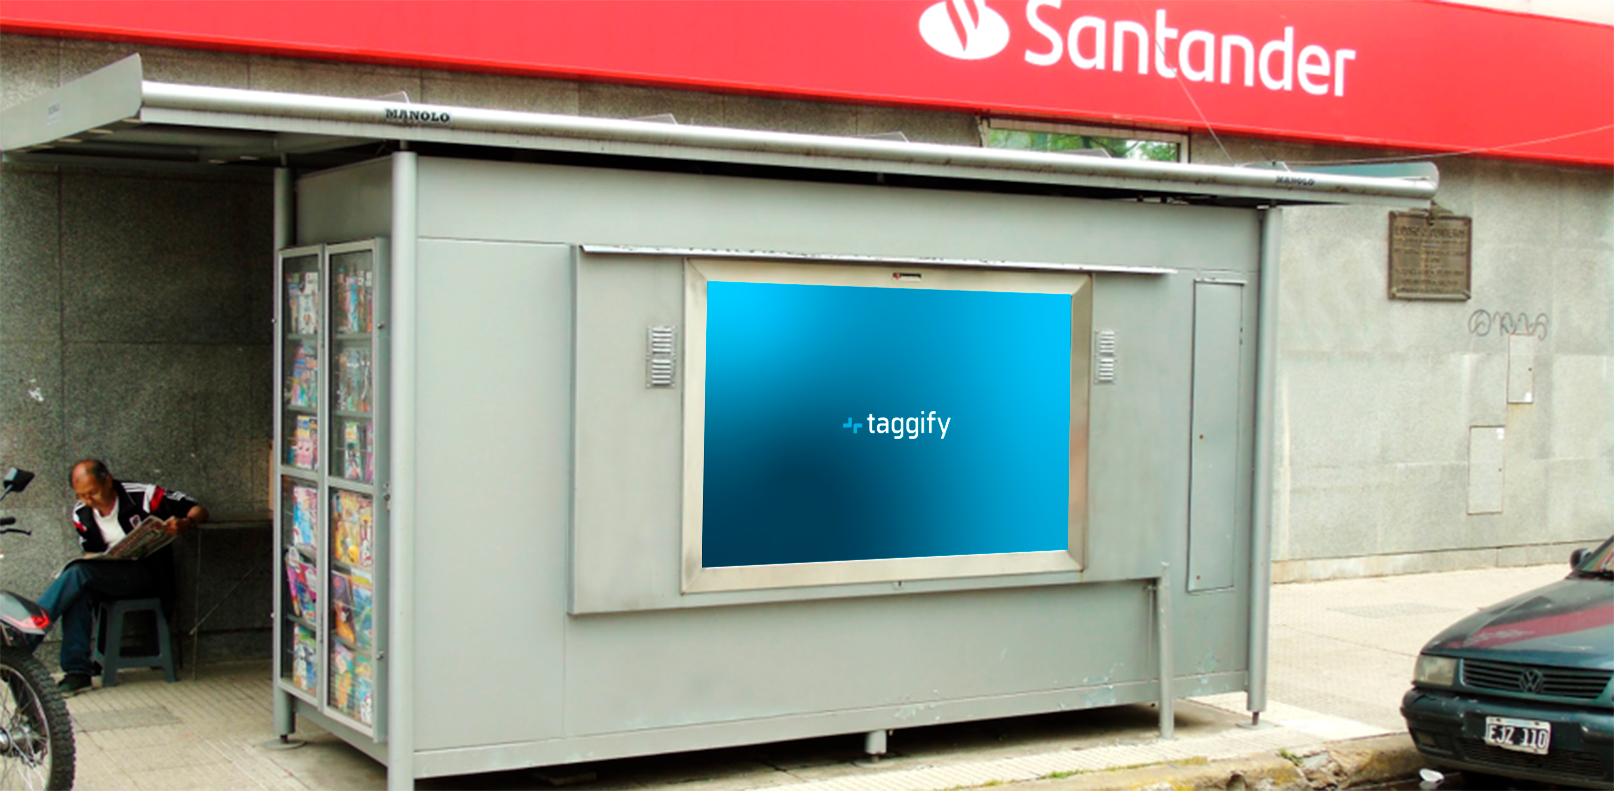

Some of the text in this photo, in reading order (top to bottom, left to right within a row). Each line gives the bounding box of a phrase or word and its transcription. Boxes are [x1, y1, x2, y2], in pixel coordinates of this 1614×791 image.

[1024, 0, 1356, 97] Santander
[384, 108, 450, 123] MANOLO
[866, 410, 951, 440] taggify
[1520, 728, 1547, 749] 110
